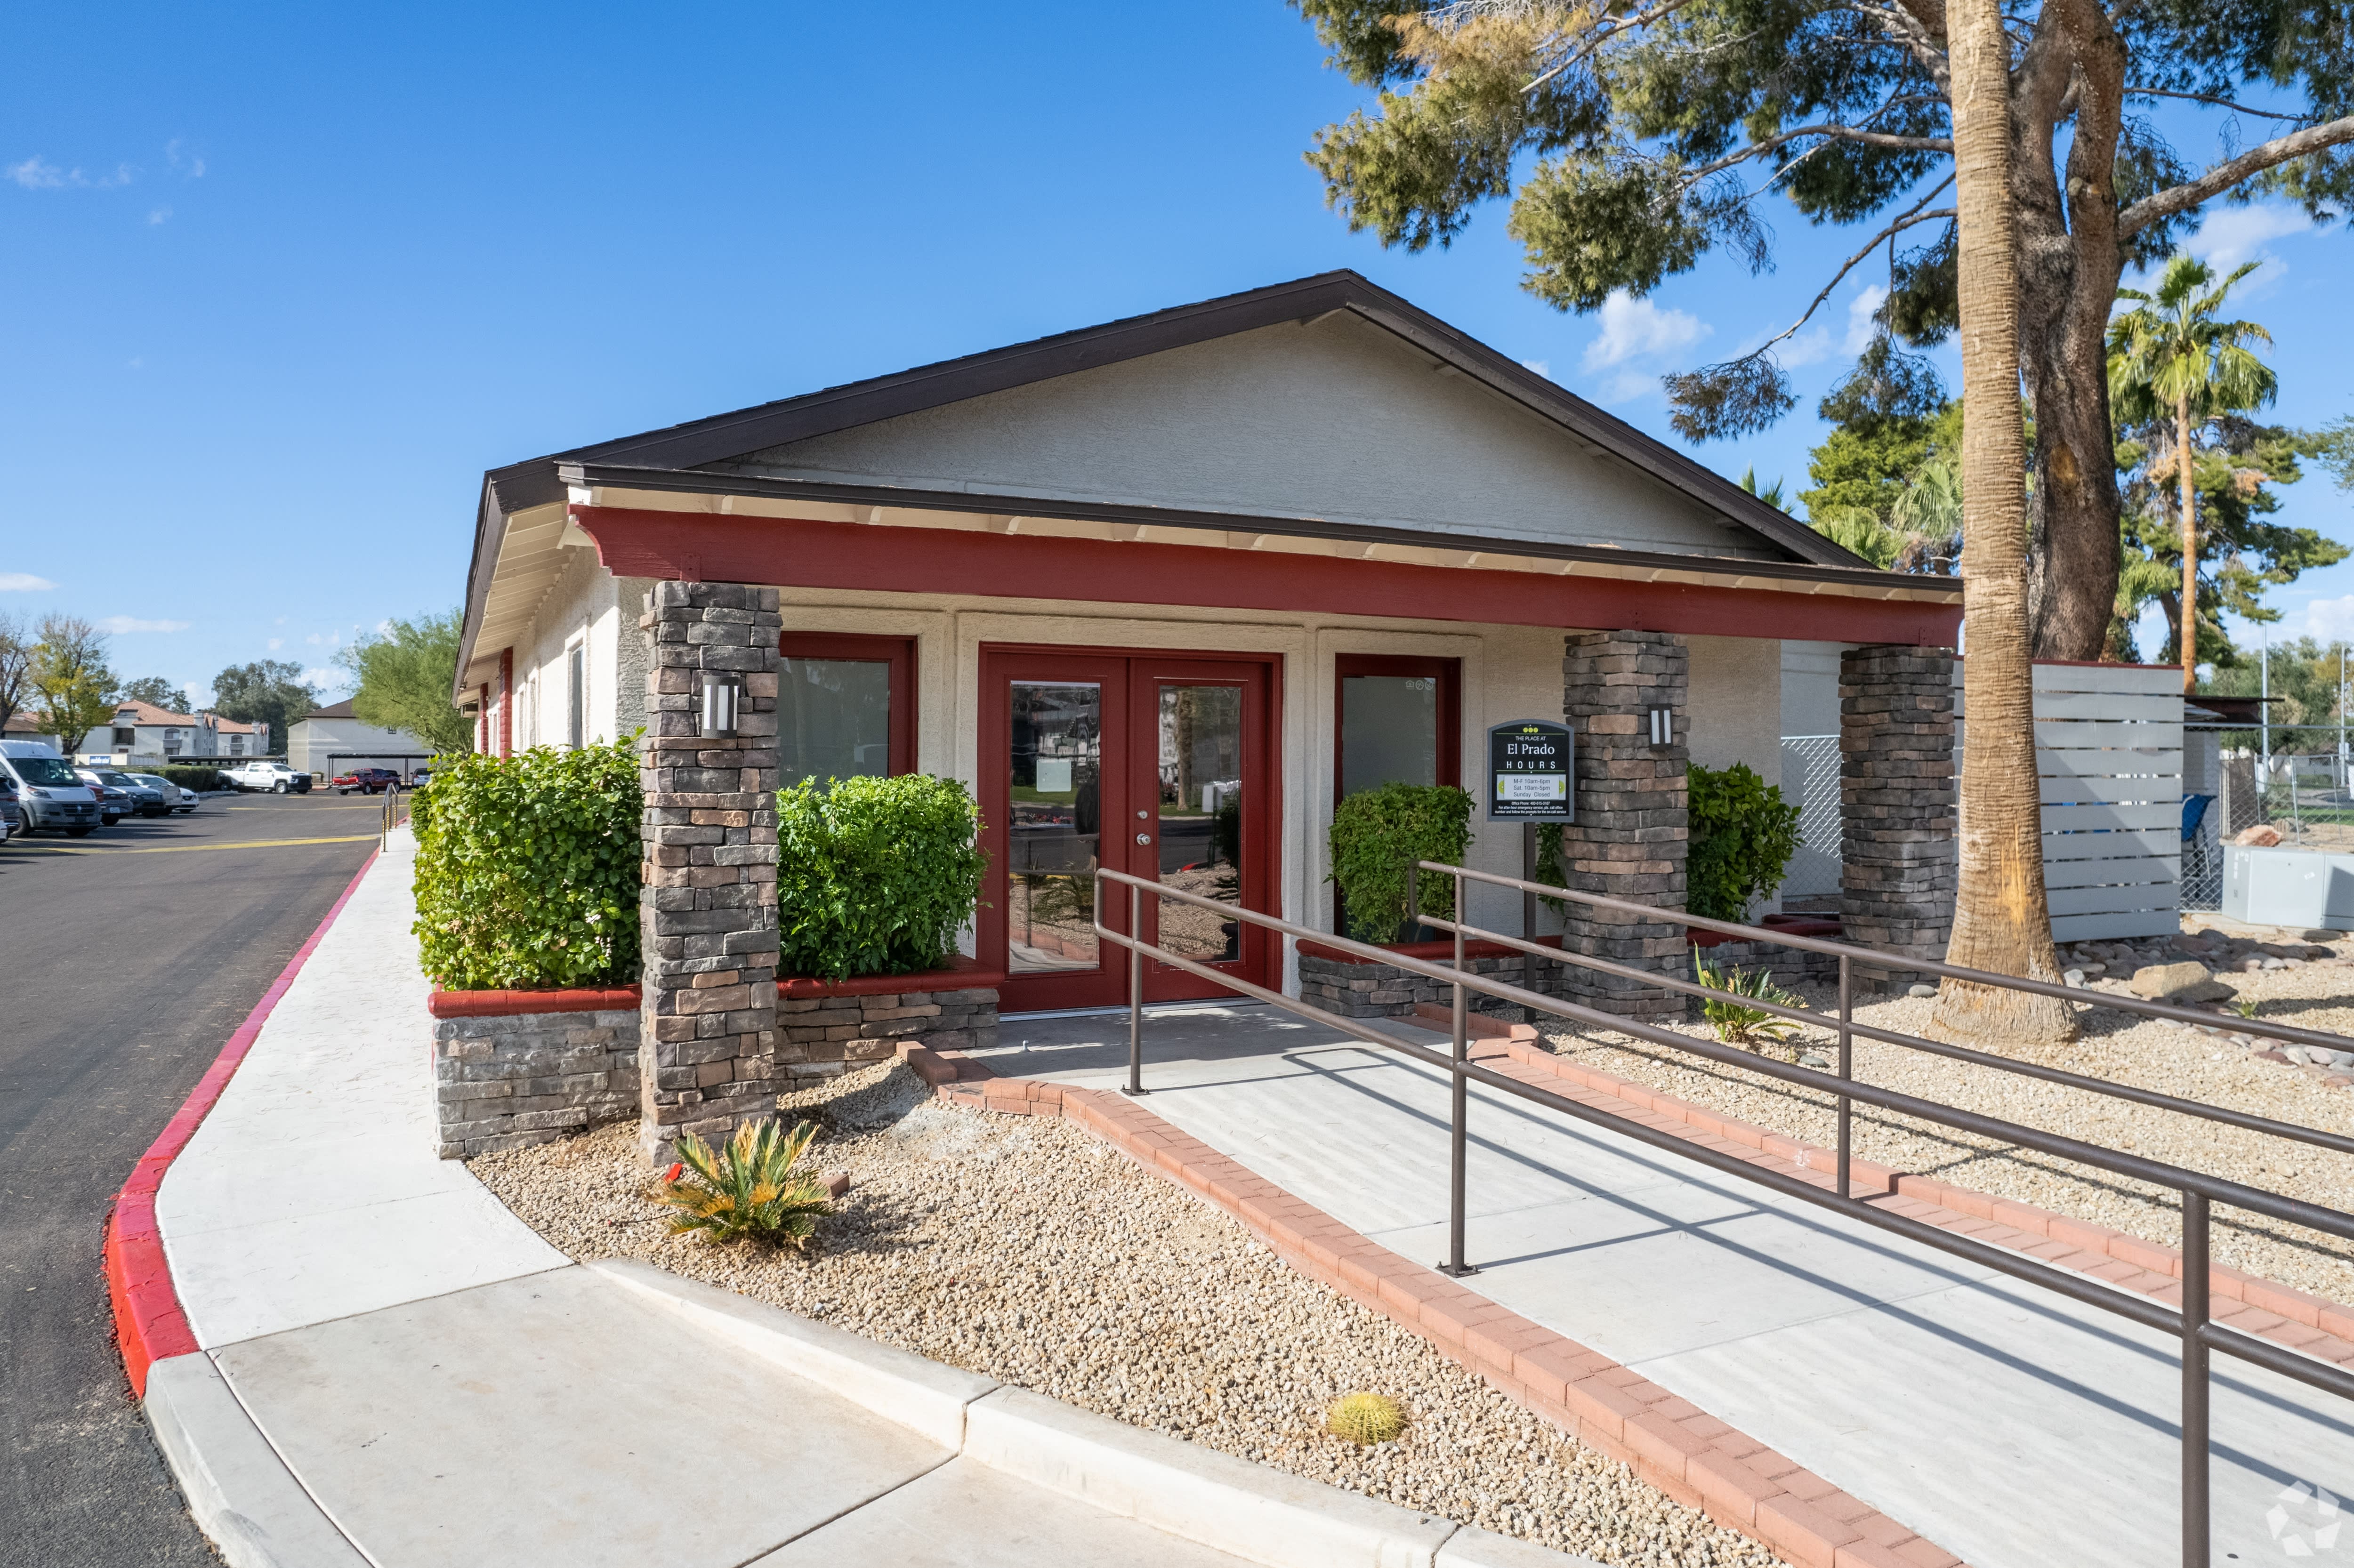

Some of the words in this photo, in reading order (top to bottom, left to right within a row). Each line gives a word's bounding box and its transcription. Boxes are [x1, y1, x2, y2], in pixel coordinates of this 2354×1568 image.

[1508, 743, 1517, 754] El
[1522, 743, 1555, 755] Prado
[1507, 761, 1556, 769] HOURS
